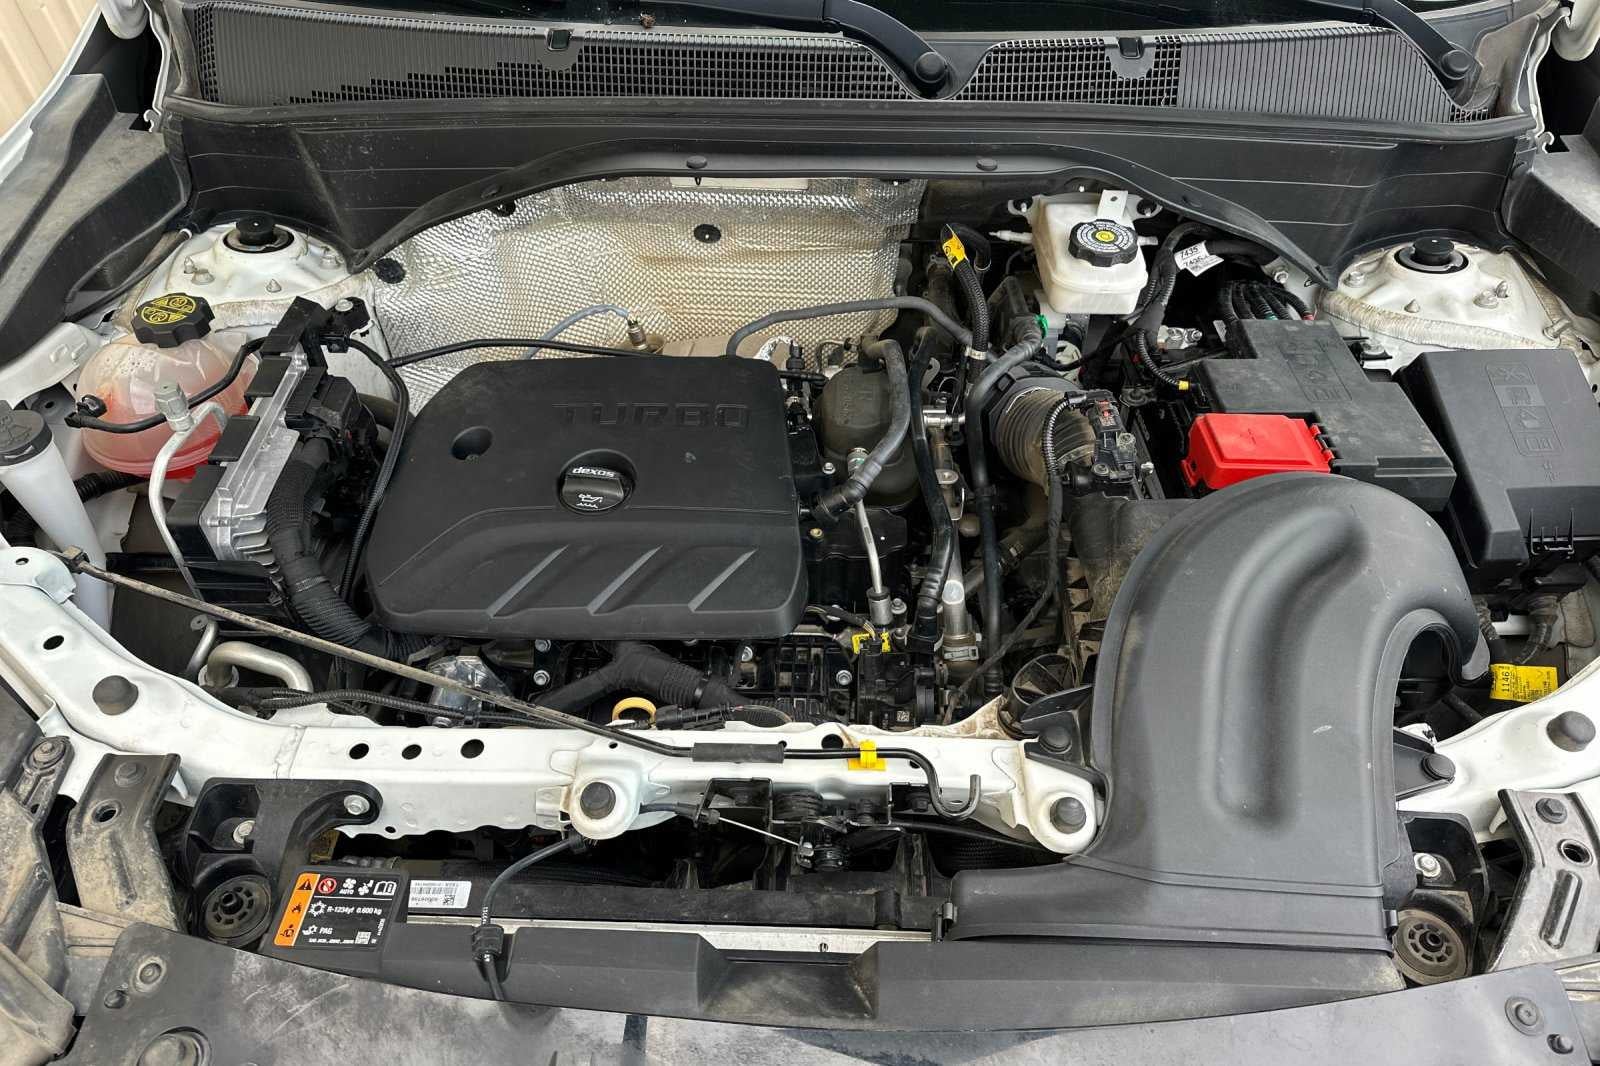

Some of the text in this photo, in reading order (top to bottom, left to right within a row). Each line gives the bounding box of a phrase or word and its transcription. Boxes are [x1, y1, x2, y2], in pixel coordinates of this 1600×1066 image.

[551, 403, 749, 427] TURBO
[572, 466, 616, 478] dexos
[1501, 671, 1510, 692] 1146
[327, 906, 355, 915] R-1234yf
[374, 908, 382, 916] kg
[319, 927, 333, 935] PAG
